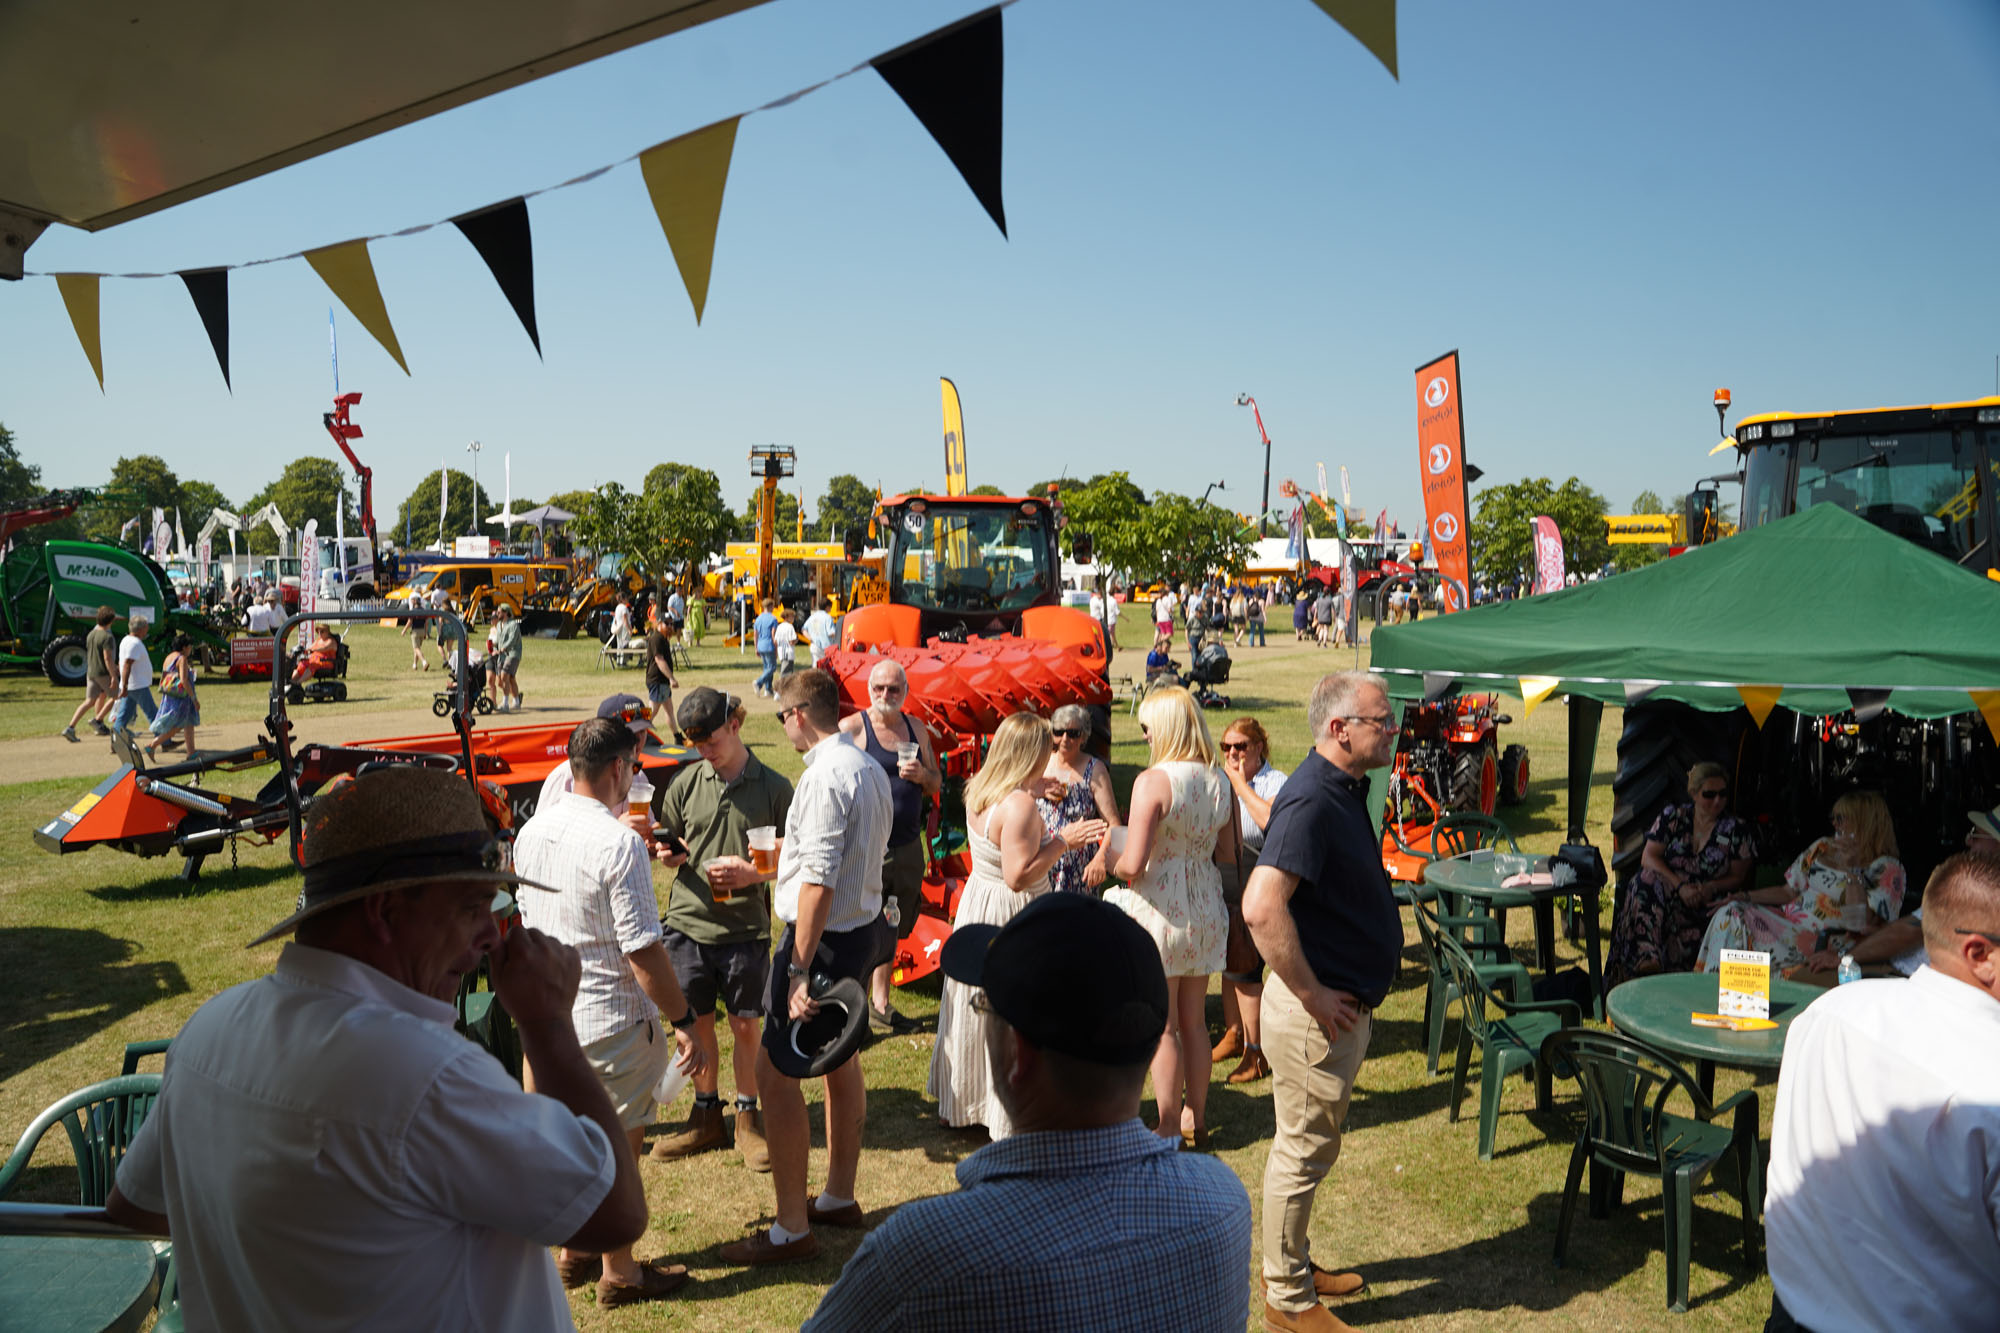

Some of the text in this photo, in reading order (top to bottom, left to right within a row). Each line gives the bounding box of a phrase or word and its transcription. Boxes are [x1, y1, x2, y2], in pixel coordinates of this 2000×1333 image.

[908, 514, 922, 528] 50
[1614, 523, 1665, 535] ROPA
[66, 564, 119, 577] McHale
[501, 574, 523, 583] JCB
